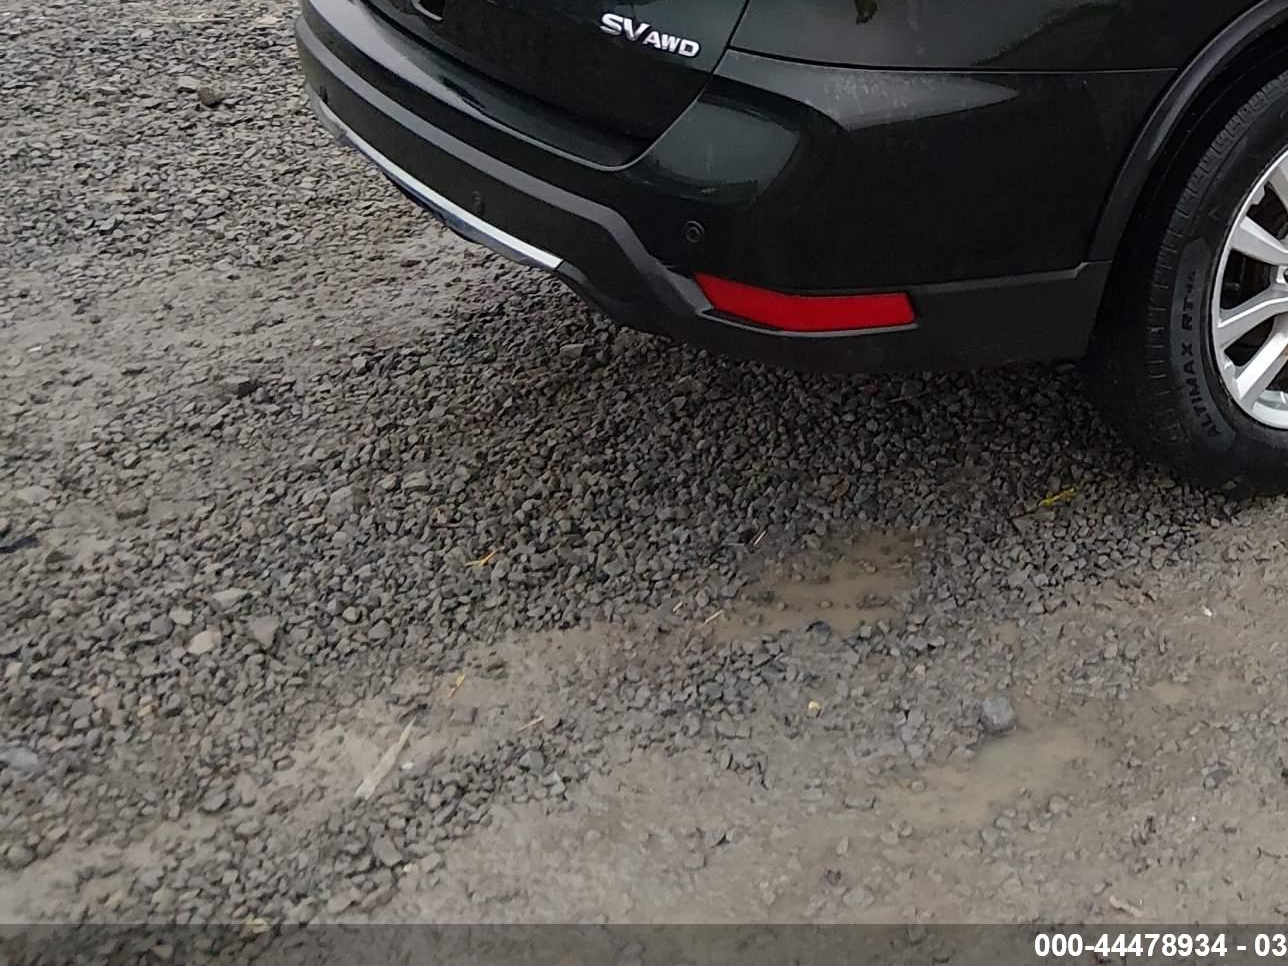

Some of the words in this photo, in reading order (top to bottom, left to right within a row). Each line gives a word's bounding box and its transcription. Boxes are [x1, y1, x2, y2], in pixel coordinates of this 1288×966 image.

[600, 13, 651, 41] SV
[642, 31, 700, 57] AWD
[1181, 342, 1222, 437] ALTIMAX
